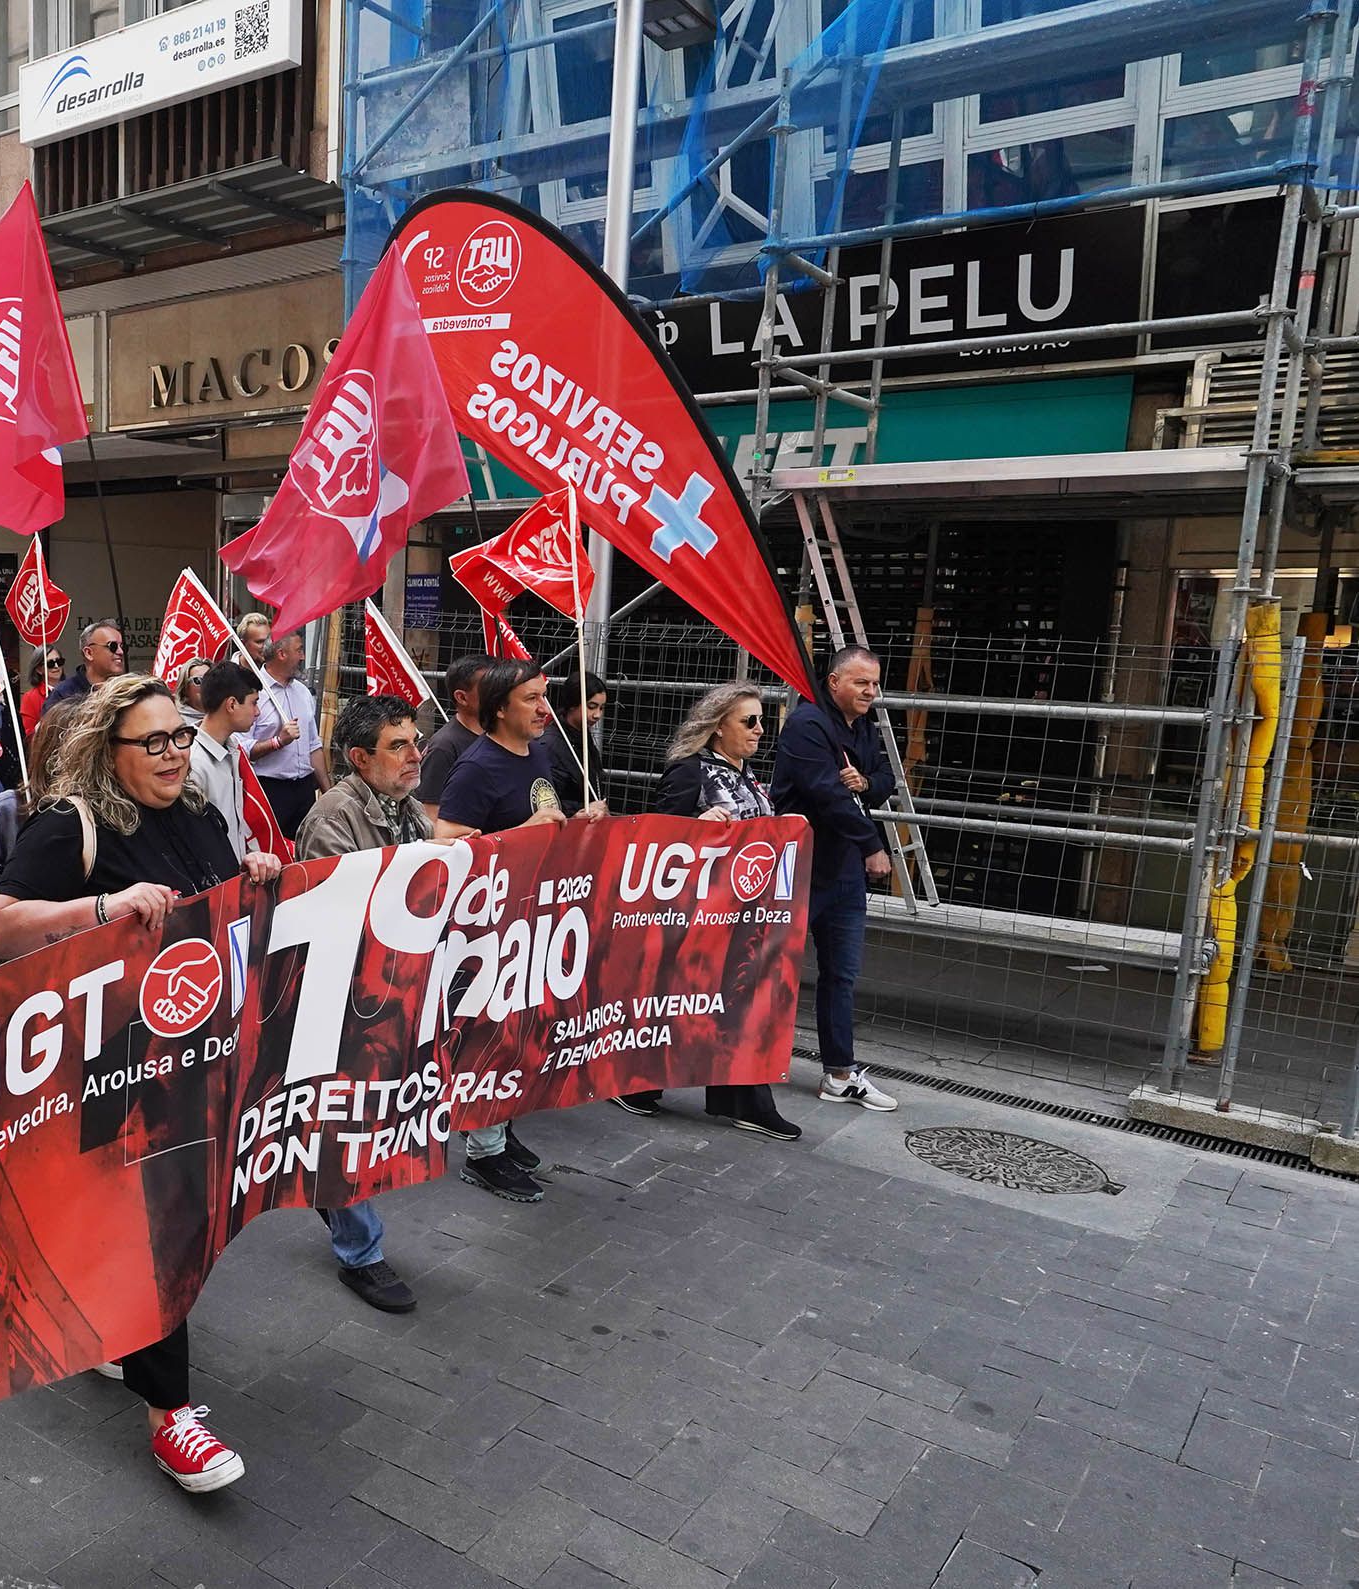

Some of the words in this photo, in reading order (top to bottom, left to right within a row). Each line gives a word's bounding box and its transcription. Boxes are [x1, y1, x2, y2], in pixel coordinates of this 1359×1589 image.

[173, 29, 191, 46] 886
[192, 25, 203, 41] 21
[204, 22, 215, 37] 41
[216, 18, 226, 34] 19
[173, 37, 225, 61] desarrolla.es
[57, 72, 145, 114] desarrolla
[709, 291, 804, 357] LA
[849, 247, 1075, 342] PELU
[454, 854, 510, 927] de
[619, 842, 731, 903] UGT
[612, 907, 690, 929] Pontevedra,
[694, 909, 740, 926] Arousa
[742, 911, 750, 923] e
[754, 907, 791, 923] Deza
[417, 880, 590, 1049] maio
[557, 874, 593, 905] 2026
[554, 998, 626, 1044] SALARIOS,
[632, 993, 725, 1019] VIVENDA
[81, 1059, 173, 1103] Arousa
[180, 1048, 195, 1069] e
[539, 1052, 555, 1075] E
[556, 1025, 672, 1071] DEMOCRACIA
[231, 1132, 322, 1208] NON
